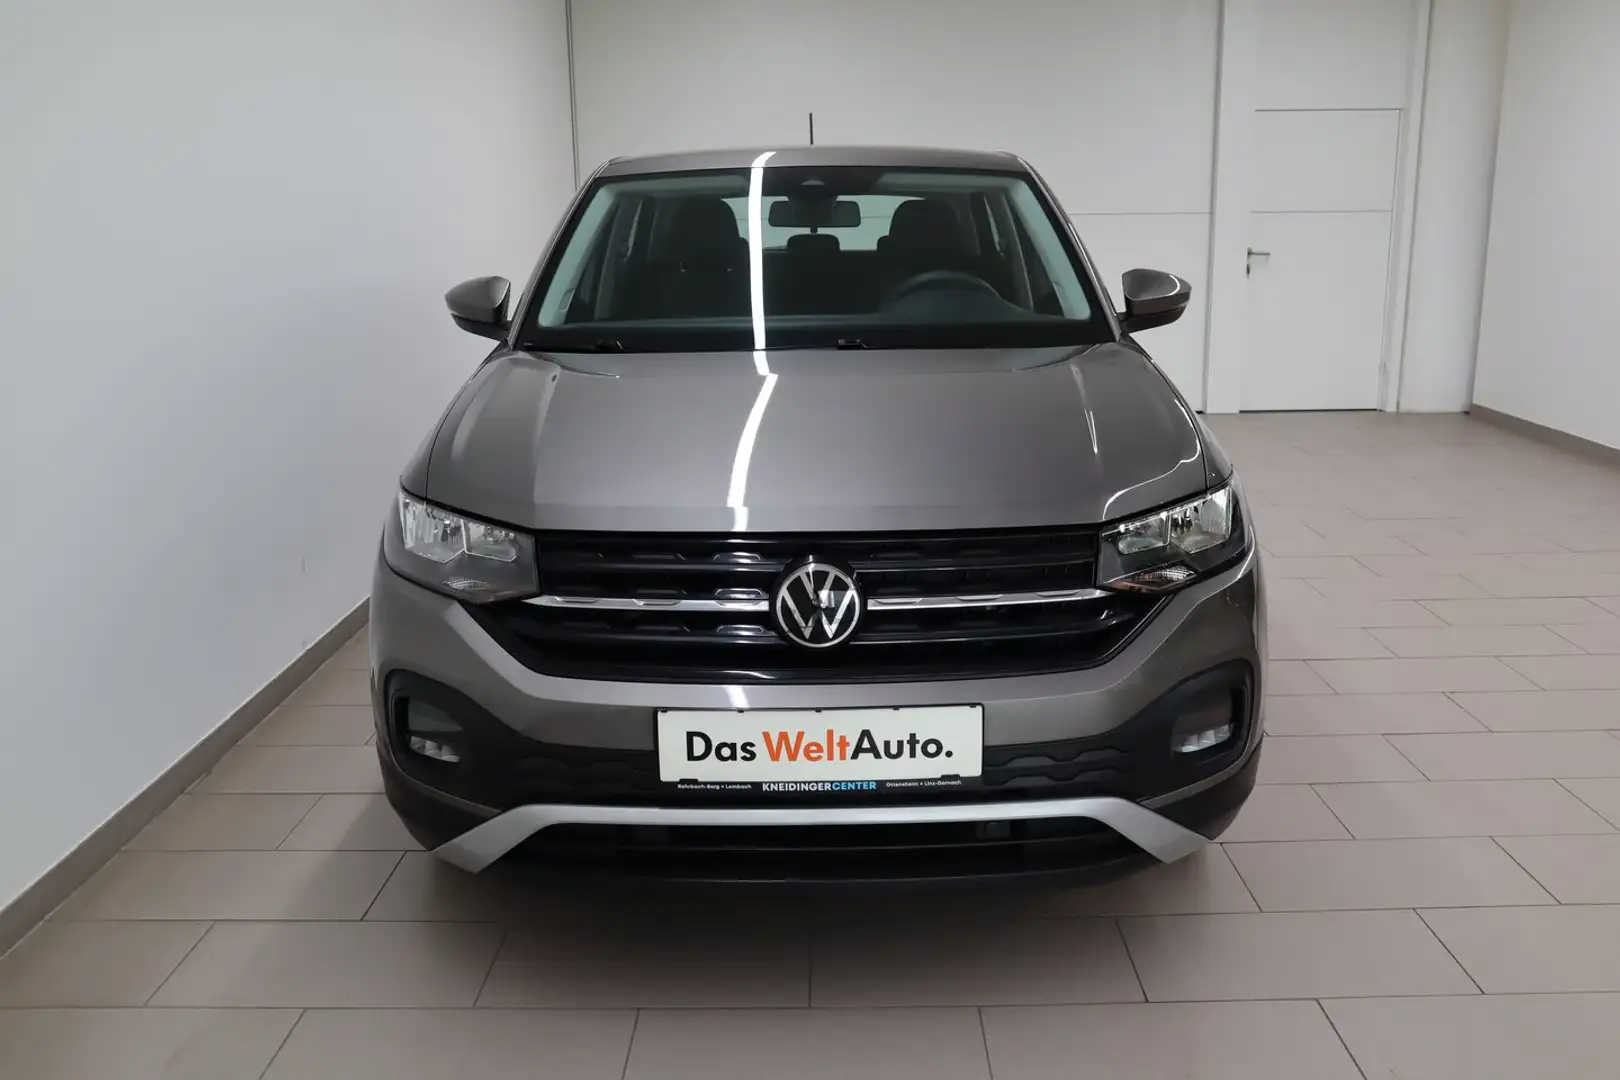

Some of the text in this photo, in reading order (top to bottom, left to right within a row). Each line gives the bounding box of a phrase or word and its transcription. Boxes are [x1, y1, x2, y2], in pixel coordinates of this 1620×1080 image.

[686, 729, 953, 762] Das WeltAuto.
[762, 781, 877, 792] KNEIDINGERCENTER
